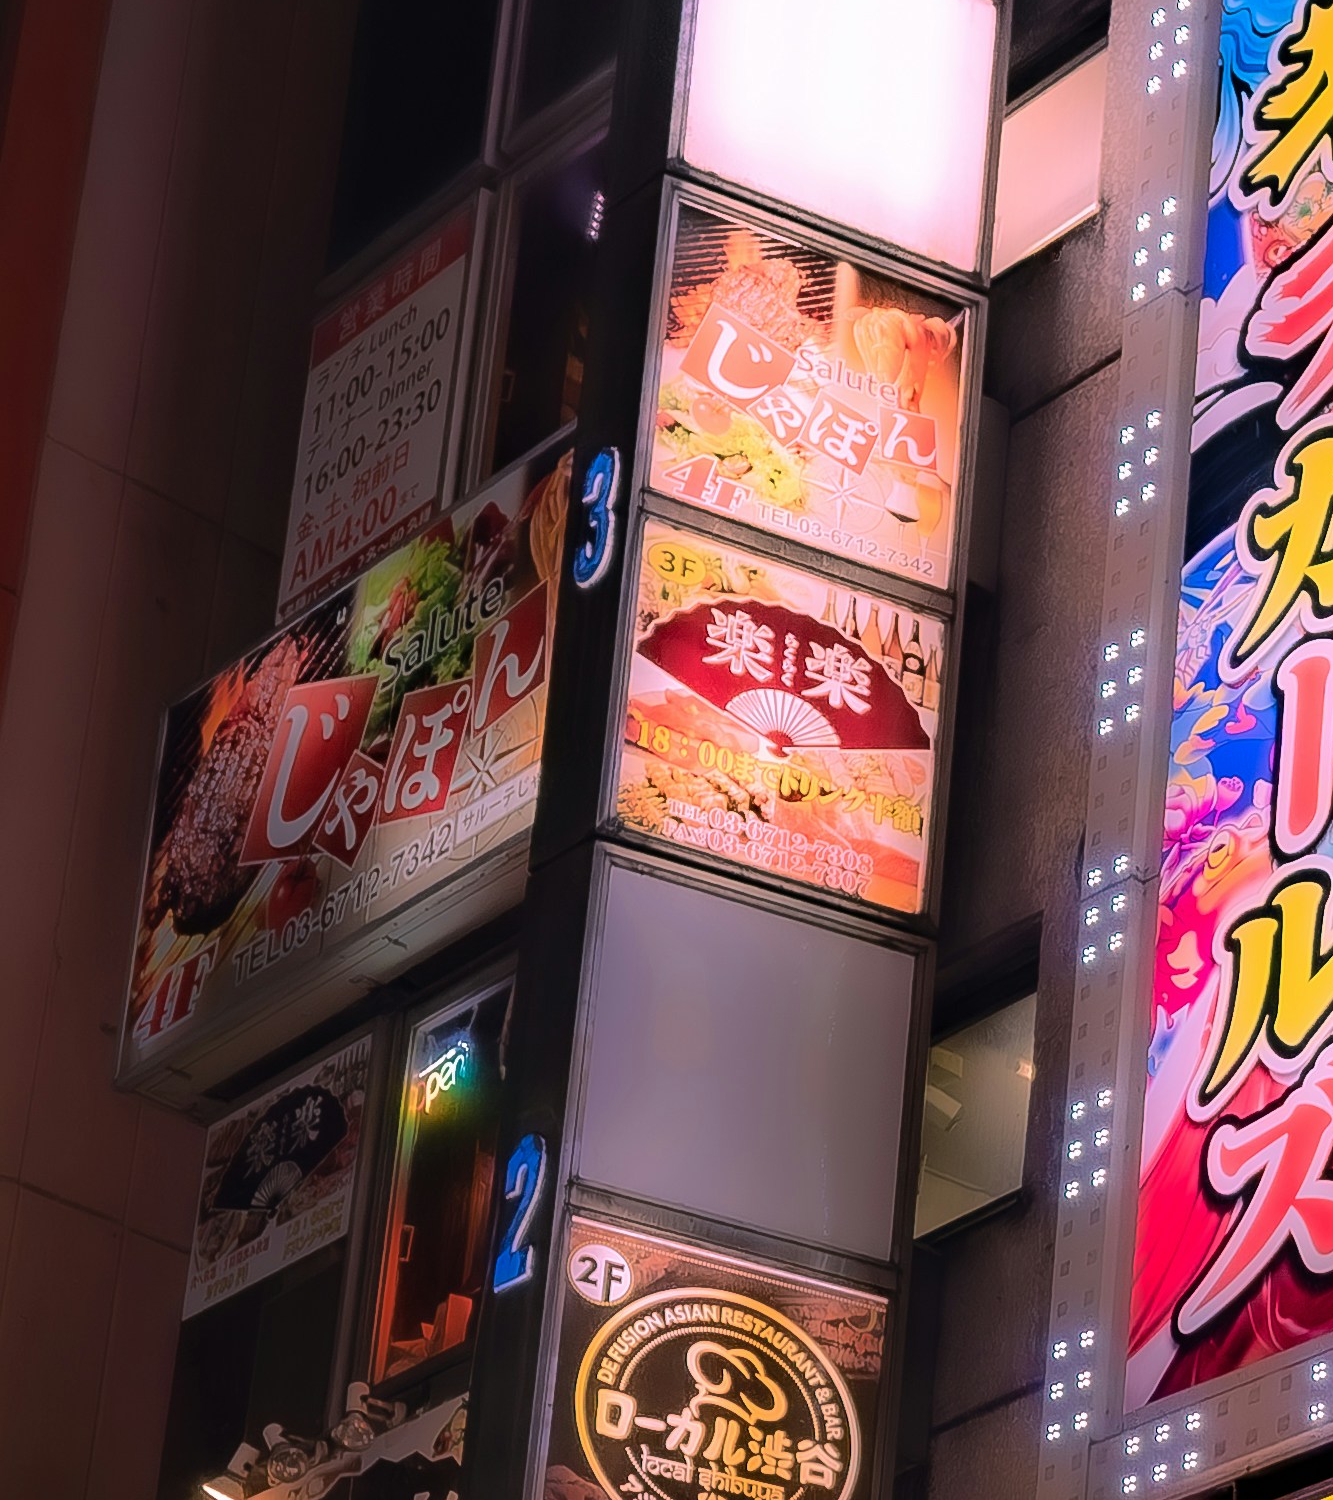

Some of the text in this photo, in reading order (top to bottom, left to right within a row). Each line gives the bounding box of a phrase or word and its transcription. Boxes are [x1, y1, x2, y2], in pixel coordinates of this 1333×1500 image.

[338, 237, 442, 342] 営業時間
[313, 307, 450, 434] 11:00-15:00
[316, 304, 418, 392] ランチ Lunch
[705, 319, 938, 469] じゃぽん
[795, 349, 900, 406] Salute
[303, 378, 442, 504] 16:00-23:30
[306, 358, 434, 465] ディナー Dinner
[574, 446, 619, 591] 3
[661, 455, 755, 514] 4F
[657, 550, 699, 581] 3F
[756, 501, 934, 578] TEL03-6712-7342
[380, 576, 504, 691] Salute
[267, 620, 545, 851] じゃぽん
[662, 817, 873, 896] FAX:03-6712-7307
[667, 800, 874, 876] TEL:03-6712-7308
[233, 822, 452, 986] TEL03-6712-7342
[133, 938, 219, 1048] 4F
[493, 1133, 546, 1294] 2
[575, 1256, 624, 1302] 2F
[664, 1303, 843, 1440] ASIAN RESTAURANT BAR
[596, 1388, 843, 1491] ローカル渋谷
[641, 1445, 693, 1484] local
